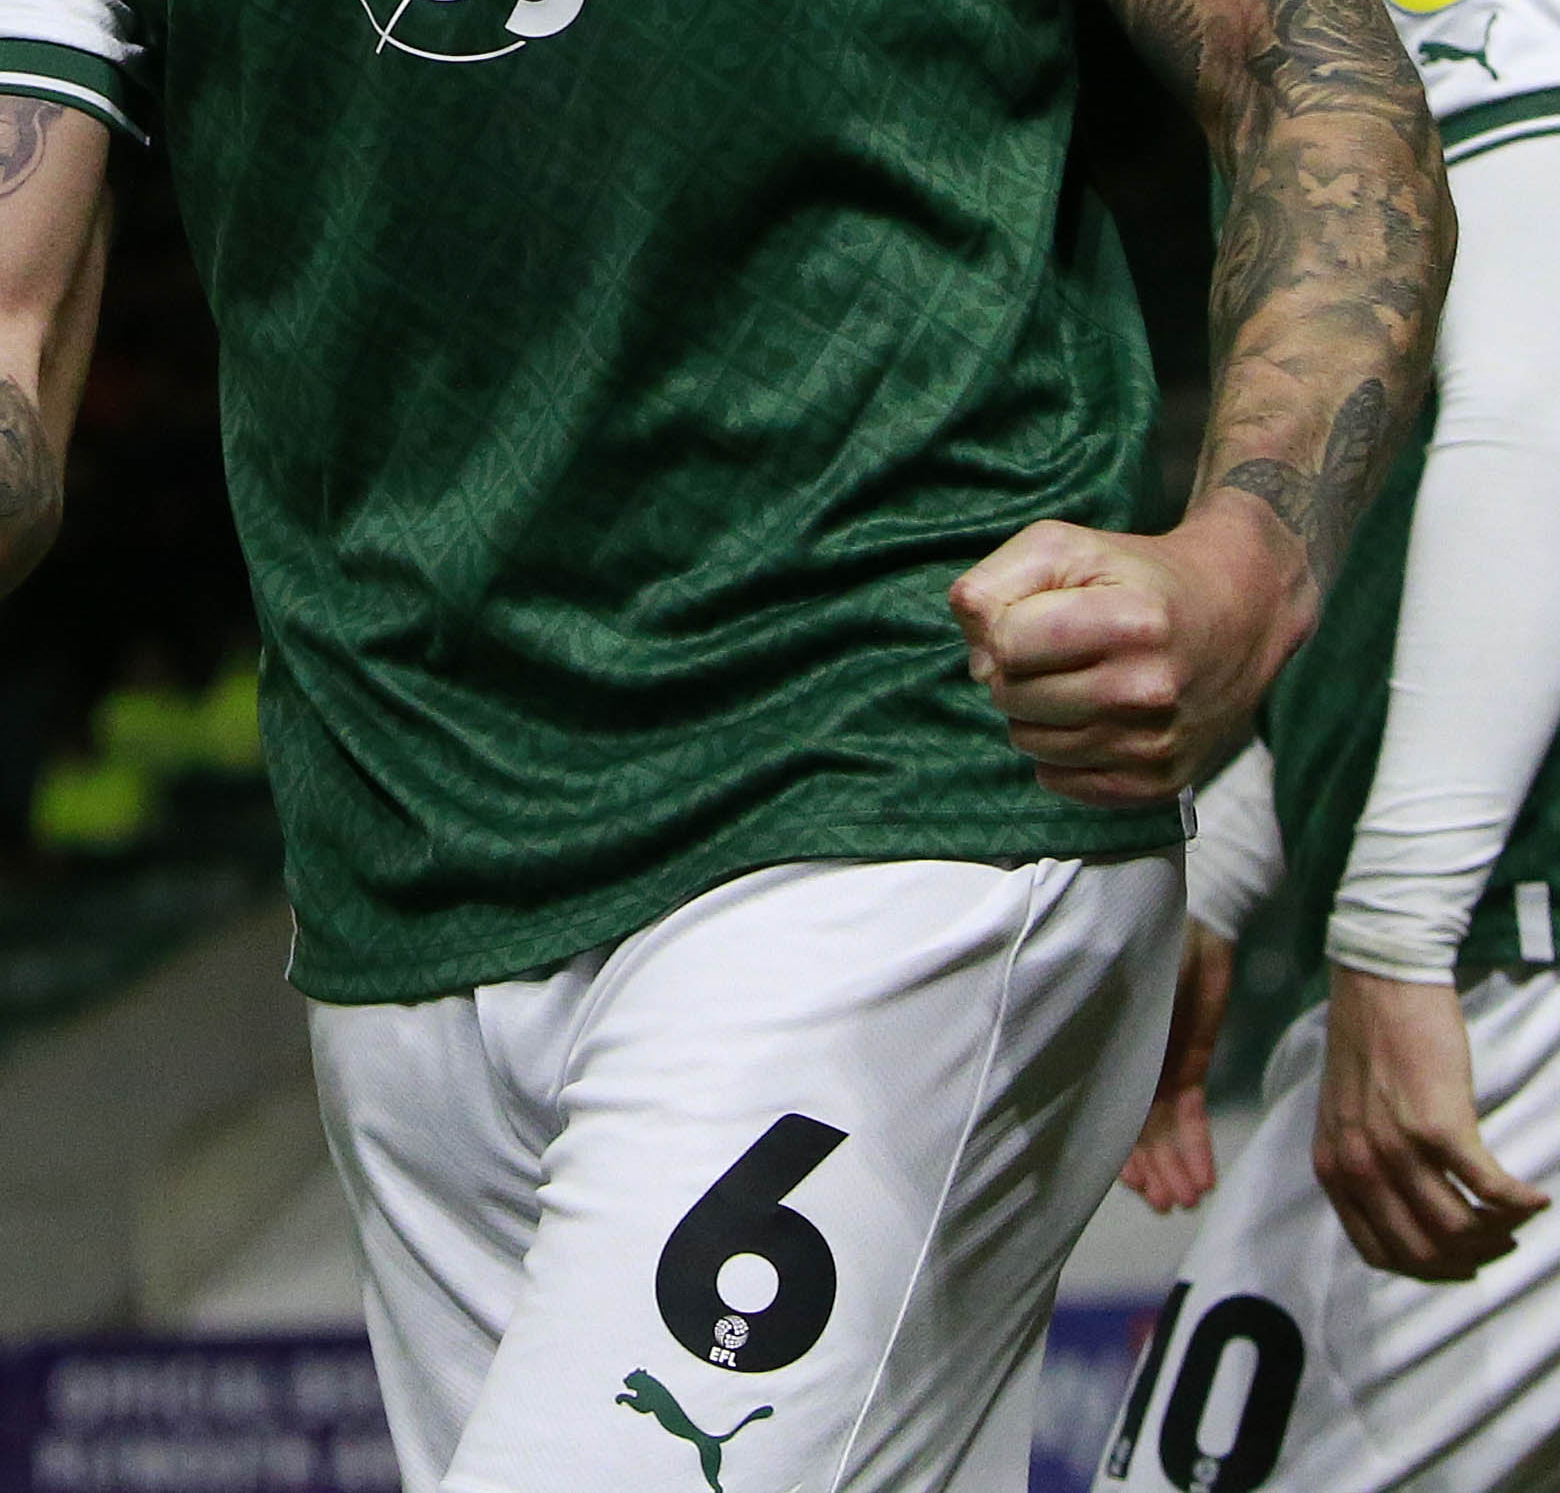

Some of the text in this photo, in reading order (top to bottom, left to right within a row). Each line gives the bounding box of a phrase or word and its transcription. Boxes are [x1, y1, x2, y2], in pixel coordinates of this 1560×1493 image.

[655, 1113, 850, 1374] 6
[709, 1346, 737, 1367] EFL
[1107, 1281, 1306, 1493] 10
